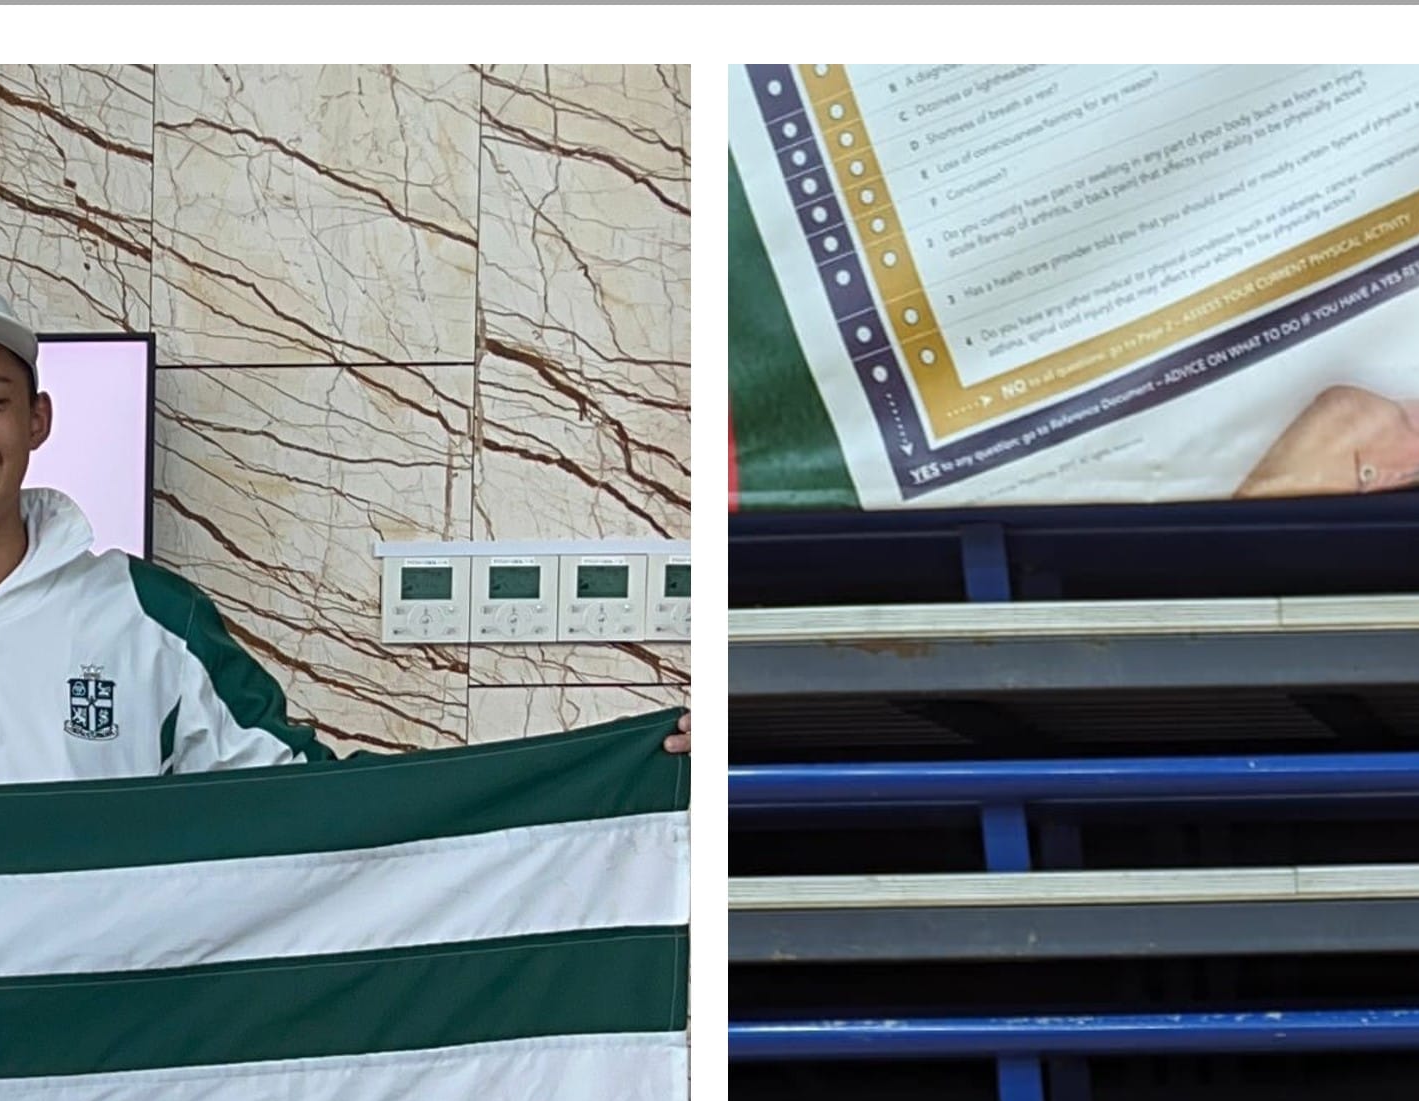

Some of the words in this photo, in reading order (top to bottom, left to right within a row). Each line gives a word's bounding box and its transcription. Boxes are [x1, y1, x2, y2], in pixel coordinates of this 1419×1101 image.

[910, 464, 940, 486] YES
[973, 436, 1020, 463] question:
[1049, 403, 1100, 431] Reference
[1101, 381, 1156, 410] Document
[1165, 360, 1207, 386] ADVICE
[1208, 351, 1229, 368] ON
[1229, 336, 1263, 359] WHAT
[1263, 328, 1282, 344] TO
[1282, 318, 1303, 336] DO
[1313, 301, 1340, 321] YOU
[1340, 287, 1371, 309] HAVE
[1381, 270, 1403, 290] YES
